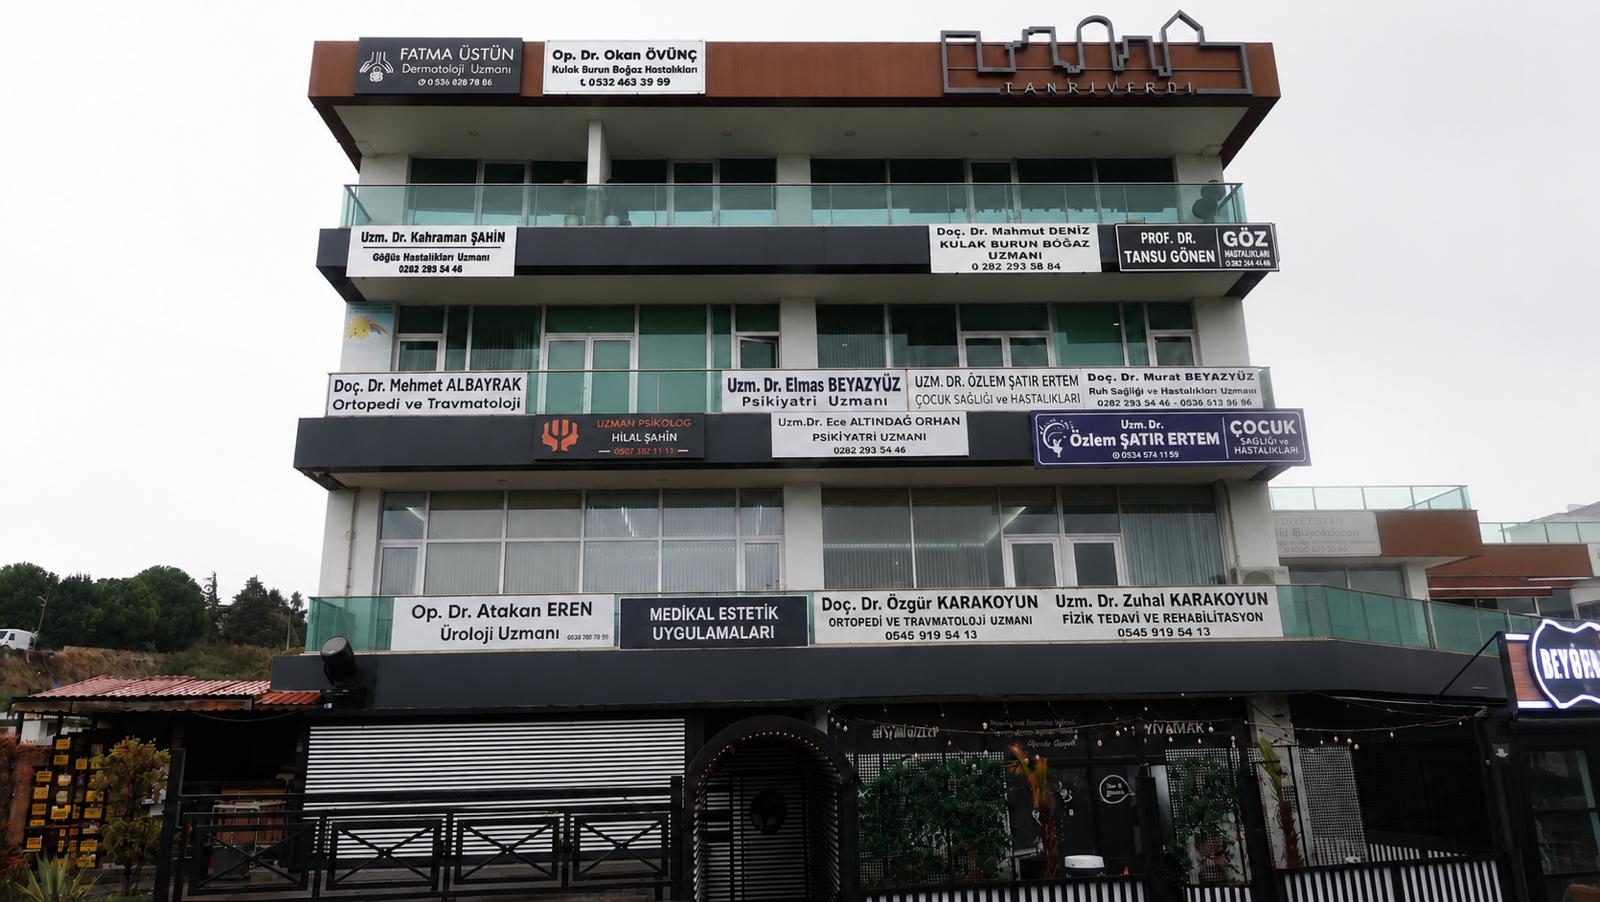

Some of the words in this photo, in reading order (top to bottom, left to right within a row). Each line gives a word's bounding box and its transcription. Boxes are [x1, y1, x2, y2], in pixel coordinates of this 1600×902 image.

[400, 47, 453, 60] FATMA
[459, 44, 514, 60] ÜSTÜN
[552, 50, 576, 62] Op.
[581, 50, 599, 60] Dr.
[604, 50, 641, 60] Okan
[646, 47, 698, 63] ÖVÜNÇ
[402, 63, 465, 76] Dermatoloji
[471, 63, 511, 74] Uzmanı
[552, 65, 579, 74] Kulak
[582, 65, 610, 74] Burun
[612, 65, 643, 76] Boğaz
[645, 65, 698, 74] Hastalıkları
[588, 78, 615, 87] 0532
[617, 78, 637, 87] 463
[640, 78, 653, 87] 39
[656, 78, 671, 87] 99
[361, 231, 388, 243] Uzm.
[392, 231, 407, 243] Dr.
[411, 231, 467, 243] Kahraman
[470, 229, 506, 245] ŞAHİN
[937, 227, 966, 239] Doç.
[970, 227, 988, 236] Dr.
[992, 227, 1045, 236] Mahmut
[1049, 225, 1090, 235] DENİZ
[1141, 232, 1174, 244] PROF.
[1177, 232, 1196, 244] DR.
[1222, 227, 1268, 247] GÖZ
[940, 240, 986, 248] KULAK
[991, 240, 1038, 248] BURUN
[372, 252, 401, 263] Göğüs
[457, 252, 490, 262] Uzmanı
[988, 251, 1042, 260] UZMANI
[1124, 250, 1167, 263] TANSU
[1170, 246, 1216, 263] GÖNEN
[439, 264, 450, 273] 54
[451, 264, 463, 273] 46
[971, 263, 979, 271] 0
[982, 263, 1002, 271] 282
[1006, 263, 1027, 271] 293
[727, 377, 760, 393] Uzm.
[764, 377, 782, 393] Dr.
[785, 377, 824, 393] Elmas
[828, 373, 901, 392] BEYAZYÜZ
[915, 375, 944, 388] UZM.
[946, 375, 965, 388] DR.
[968, 372, 1006, 388] ÖZLEM
[1009, 375, 1039, 390] ŞATIR
[1042, 375, 1079, 387] ERTEM
[1087, 373, 1117, 384] Doç.
[1121, 373, 1139, 382] Dr.
[1144, 373, 1180, 382] Murat
[1185, 370, 1255, 381] BEYAZYÜZ
[333, 379, 363, 395] Doç.
[368, 379, 386, 392] Dr.
[390, 378, 443, 392] Mehmet
[446, 377, 522, 392] ALBAYRAK
[1089, 387, 1108, 396] Ruh
[1161, 387, 1217, 395] Hastalıkları
[1220, 387, 1257, 395] Uzmanı
[332, 398, 400, 412] Ortopedi
[405, 401, 423, 410] ve
[427, 397, 521, 411] Travmatoloji
[742, 396, 817, 409] Psikiyatri
[828, 396, 888, 407] Uzmanı
[915, 394, 951, 409] ÇOCUK
[954, 392, 993, 405] SAĞLIĞI
[996, 396, 1008, 404] ve
[1011, 393, 1080, 404] HASTALIKLARI
[1144, 399, 1156, 407] 54
[1159, 399, 1171, 407] 46
[597, 419, 635, 429] UZMAN
[826, 418, 847, 427] Ece
[850, 414, 912, 426] ALTINDAĞ
[915, 416, 961, 426] ORHAN
[1121, 419, 1147, 429] Uzm.
[1148, 419, 1164, 429] Dr.
[1229, 420, 1297, 438] ÇOCUK
[612, 431, 642, 442] HİLAL
[644, 430, 677, 444] ŞAHİN
[812, 431, 877, 442] PSİKİYATRİ
[880, 433, 927, 442] UZMANI
[1070, 429, 1116, 447] Özlem
[1120, 432, 1165, 450] ŞATIR
[1167, 431, 1220, 446] ERTEM
[834, 446, 857, 455] 0282
[859, 446, 877, 454] 293
[880, 446, 892, 454] 54
[894, 446, 906, 454] 46
[1234, 446, 1299, 455] HASTALIKLARI
[821, 597, 856, 615] Doç.
[861, 597, 882, 611] Dr.
[886, 593, 932, 614] Özgür
[938, 595, 1038, 610] KARAKOYUN
[1055, 594, 1093, 608] Uzm.
[1097, 594, 1118, 608] Dr.
[1123, 592, 1165, 608] Zuhal
[1170, 592, 1268, 606] KARAKOYUN
[412, 604, 442, 622] Op.
[448, 604, 472, 619] Dr.
[476, 603, 541, 618] Atakan
[547, 601, 592, 617] EREN
[650, 605, 715, 621] MEDİKAL
[719, 603, 779, 620] ESTETİK
[1062, 610, 1094, 625] FİZİK
[1097, 610, 1140, 624] TEDAVİ
[1143, 613, 1160, 623] VE
[1163, 609, 1264, 623] REHABİLİTASYON
[829, 615, 882, 627] ORTOPEDİ
[886, 617, 900, 627] VE
[903, 614, 986, 627] TRAVMATOLOJİ
[990, 616, 1033, 626] UZMANI
[440, 624, 493, 645] Üroloji
[498, 626, 559, 641] Uzmanı
[653, 625, 774, 640] UYGULAMALARI
[885, 631, 915, 641] 0545
[919, 631, 941, 640] 919
[945, 630, 960, 640] 54
[964, 630, 977, 640] 13
[1117, 628, 1147, 637] 0545
[1151, 627, 1173, 637] 919
[1177, 627, 1193, 637] 54
[1196, 627, 1211, 637] 13
